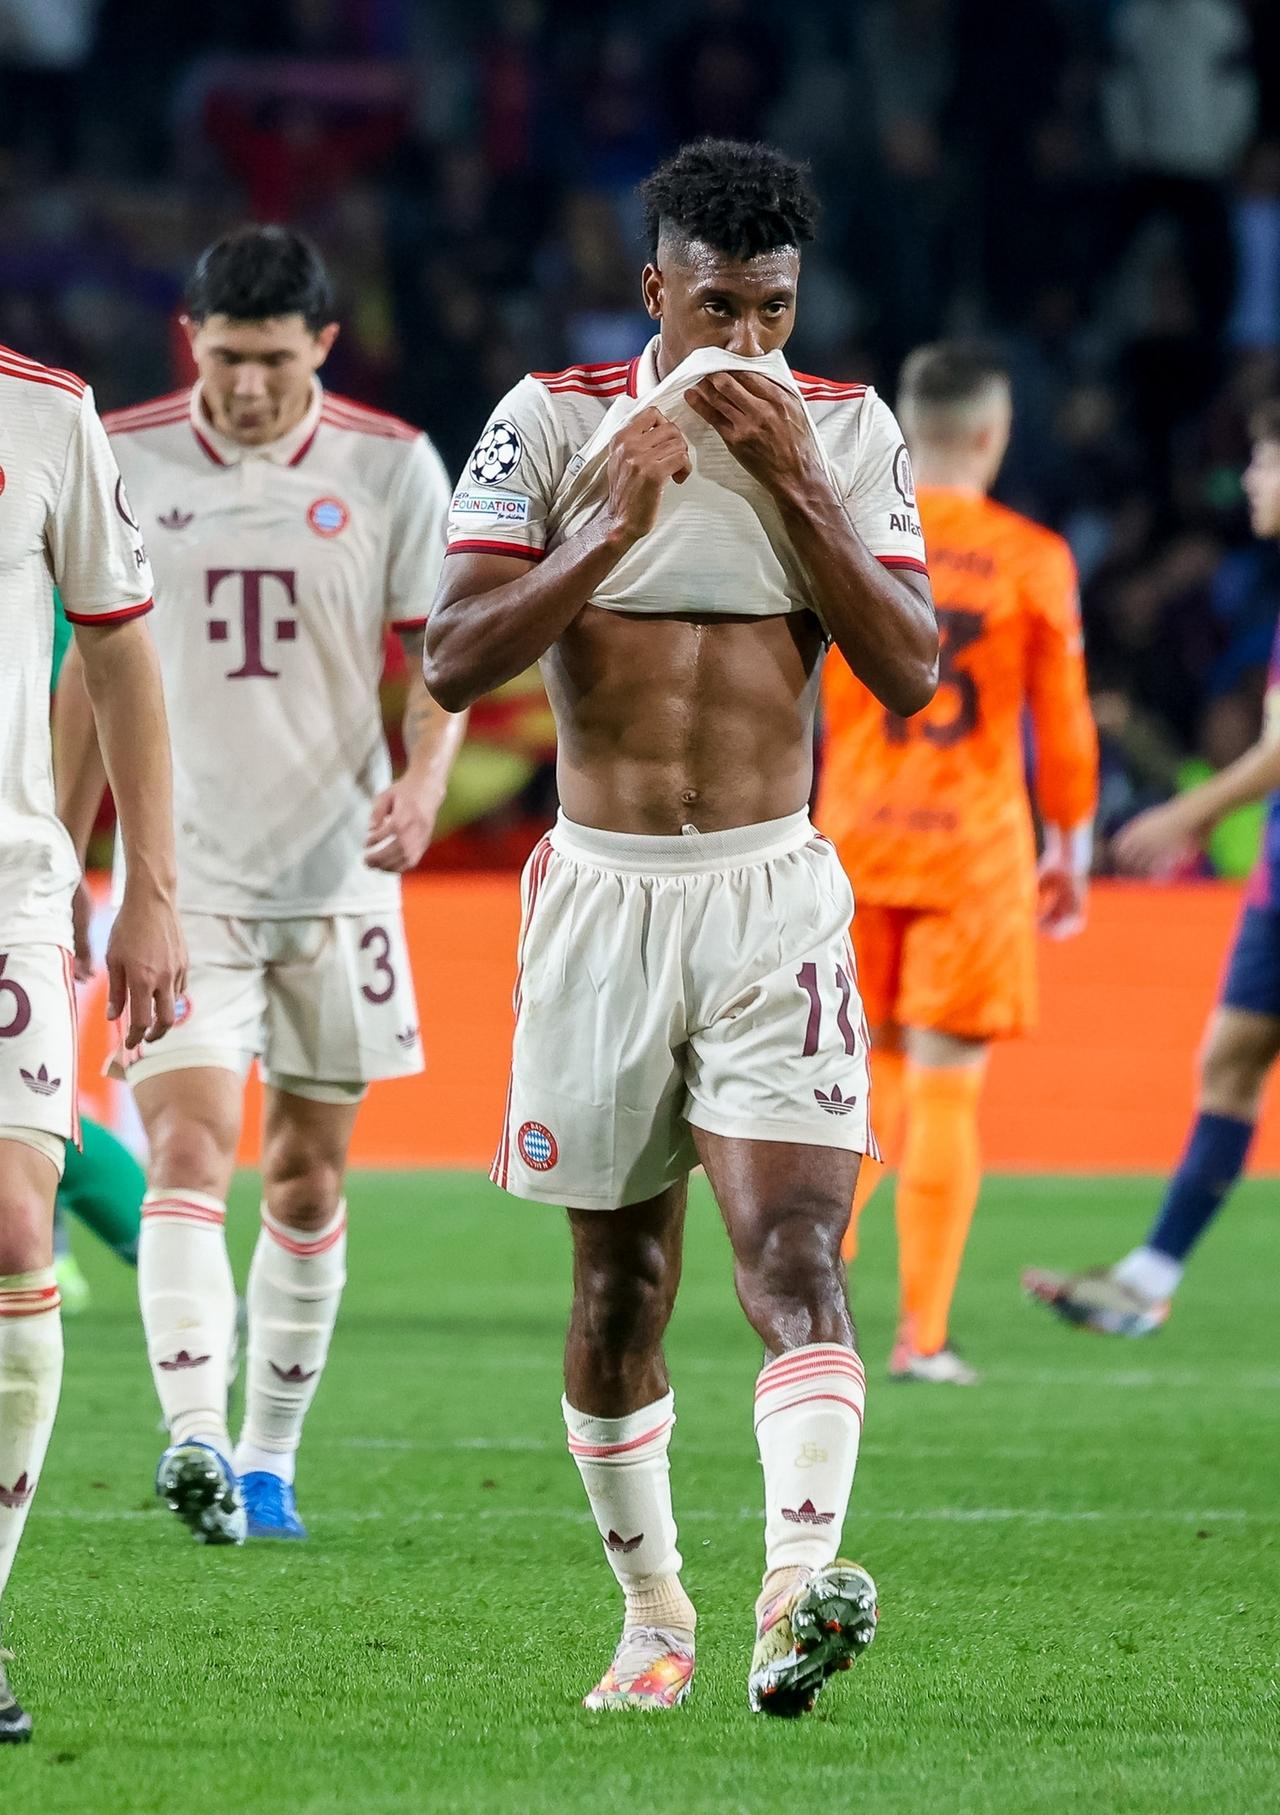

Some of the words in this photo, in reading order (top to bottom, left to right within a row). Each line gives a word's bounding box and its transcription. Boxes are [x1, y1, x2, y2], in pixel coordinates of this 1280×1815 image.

[453, 500, 526, 512] FOUNDATION
[206, 569, 297, 680] T
[885, 608, 986, 749] 3
[359, 926, 396, 1005] 3
[795, 961, 856, 1058] 11
